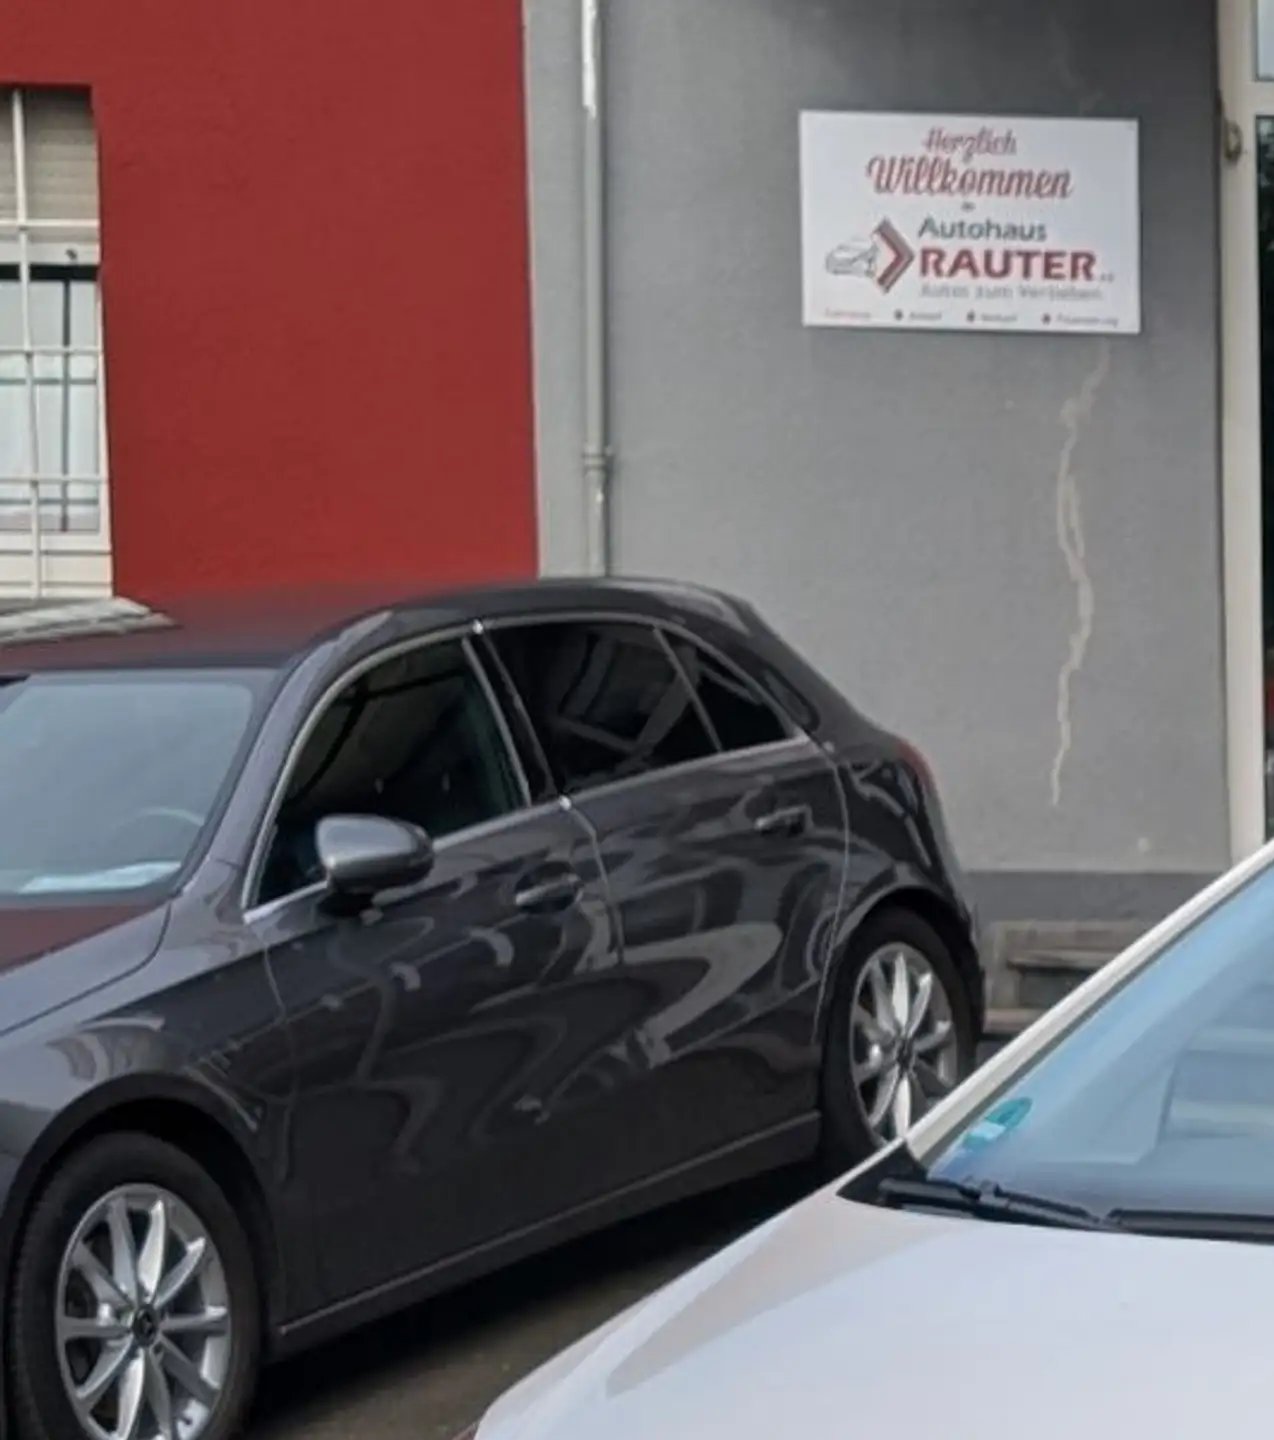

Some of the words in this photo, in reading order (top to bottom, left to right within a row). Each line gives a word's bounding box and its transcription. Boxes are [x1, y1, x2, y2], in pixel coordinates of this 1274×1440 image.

[923, 126, 1018, 163] Herzlich
[866, 154, 1076, 199] Willkommen
[918, 216, 1048, 242] Autohaus
[919, 247, 1097, 282] RAUTER
